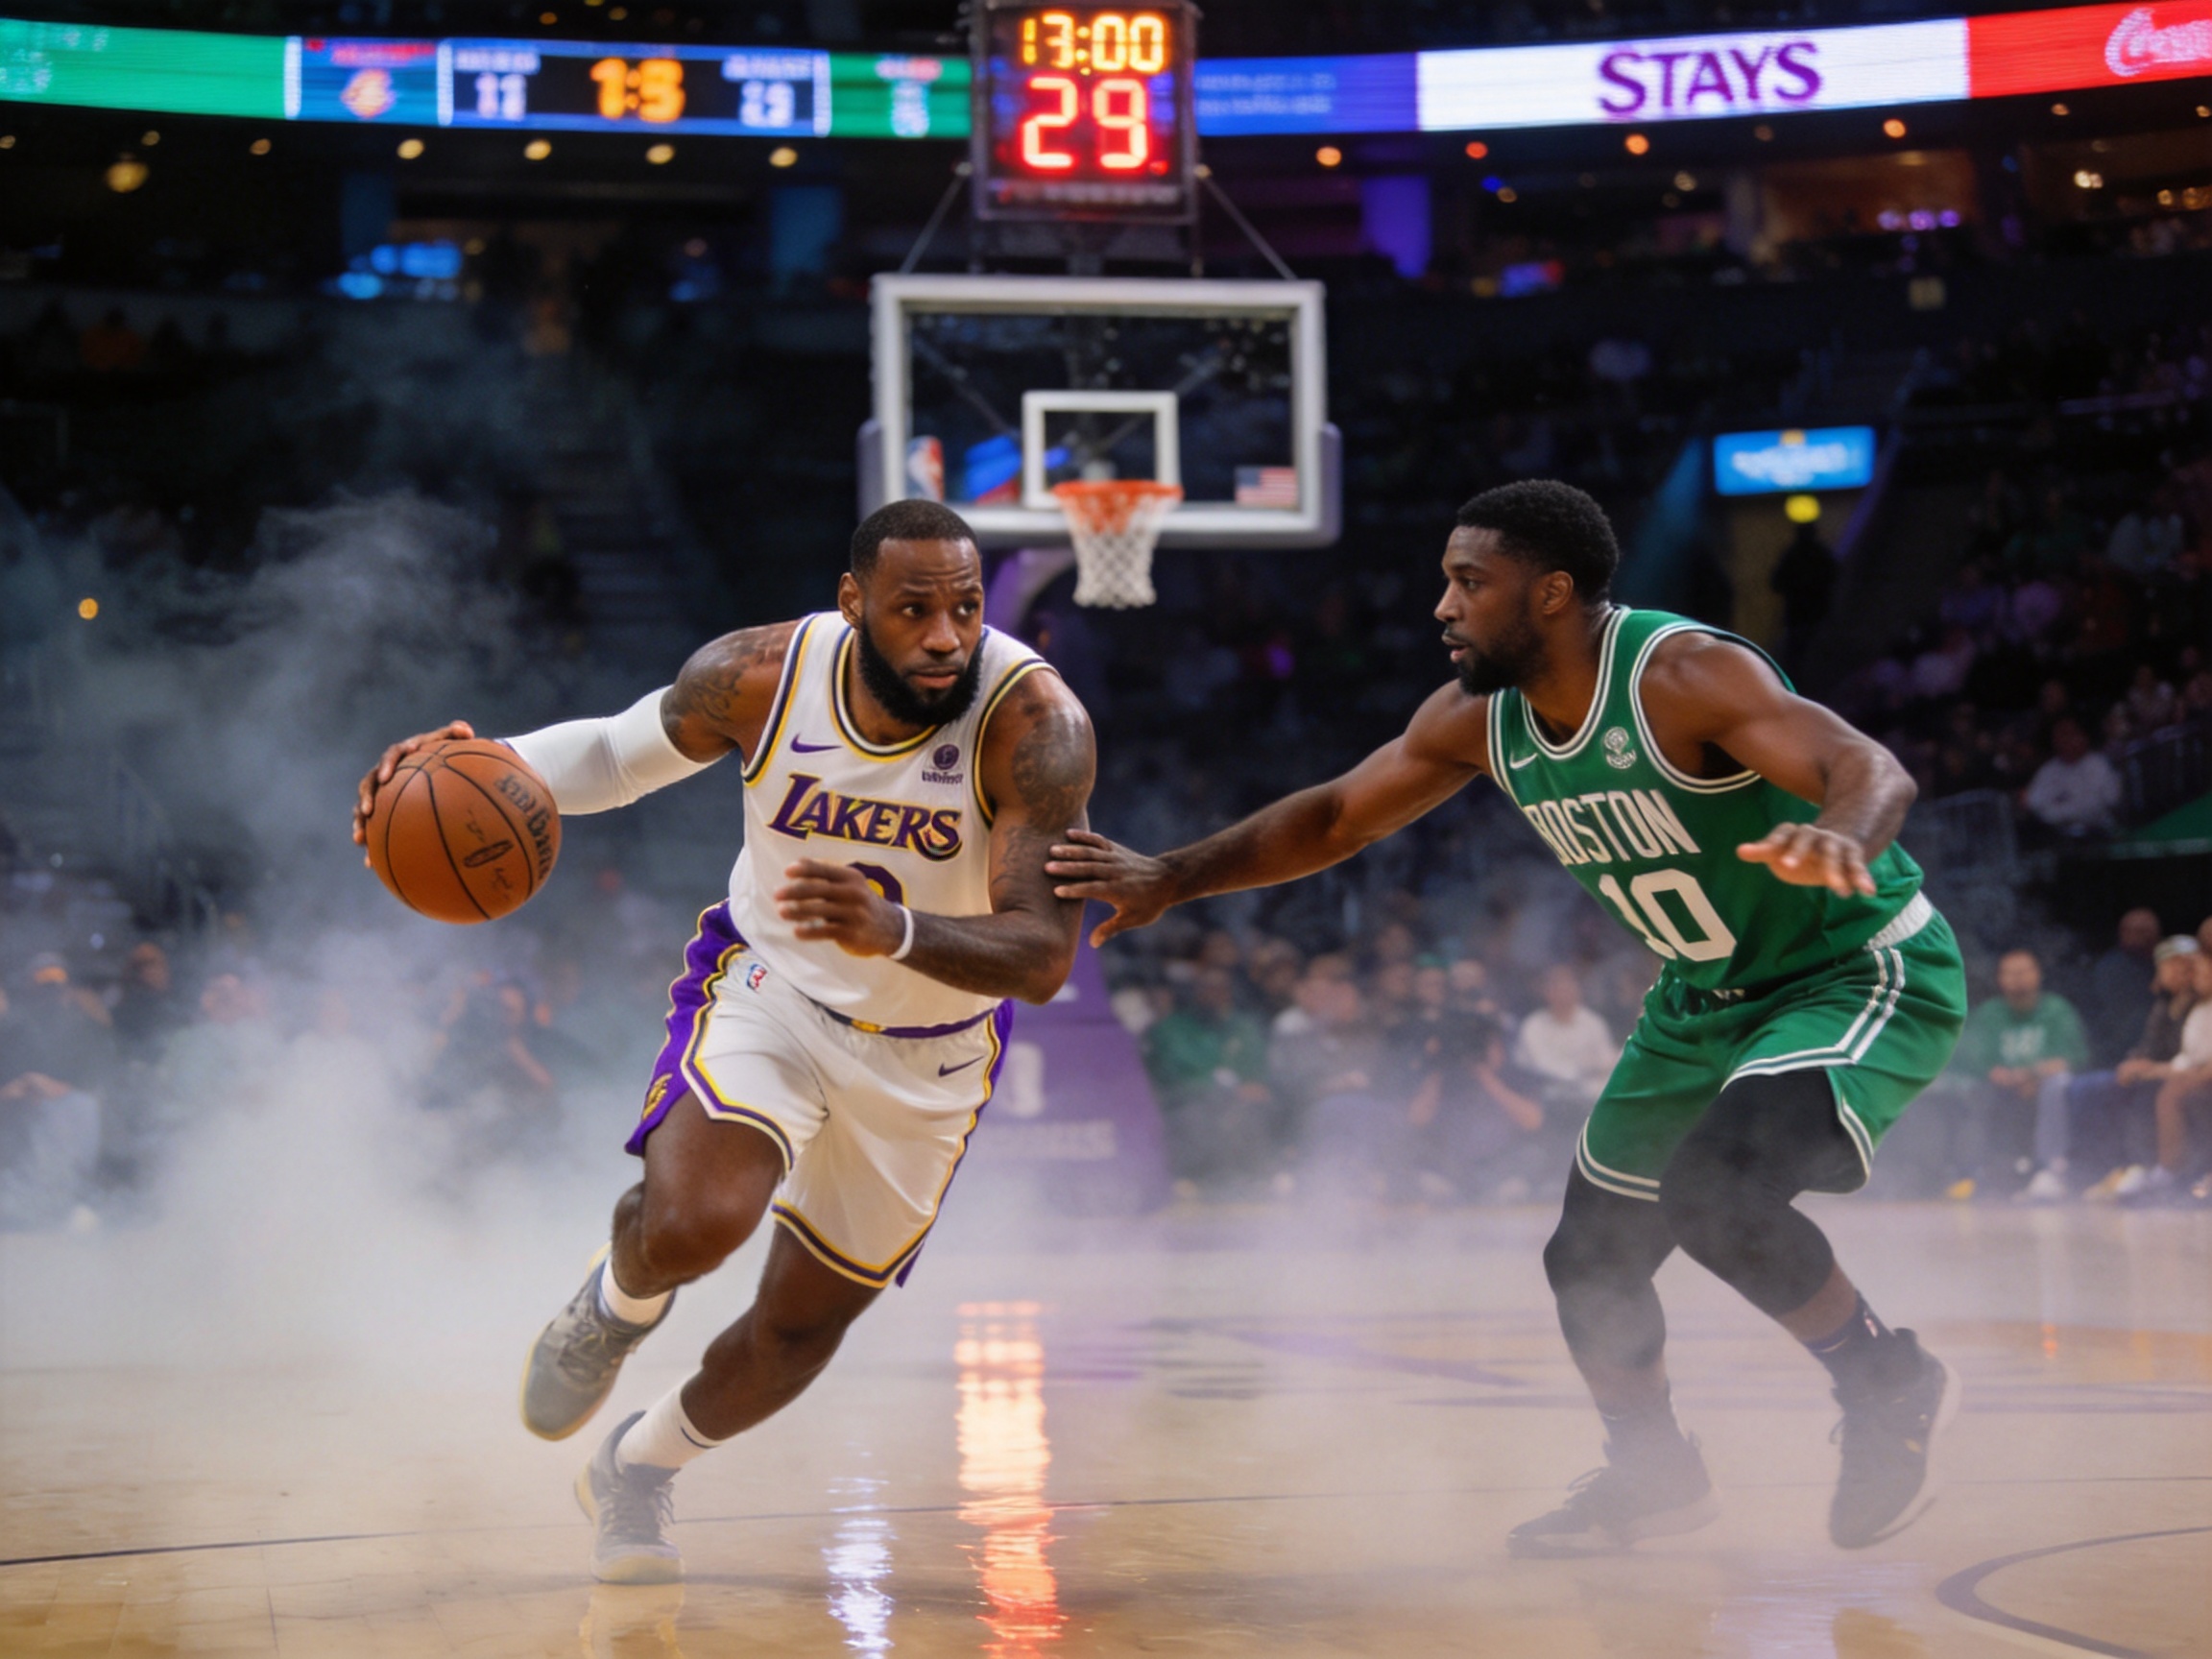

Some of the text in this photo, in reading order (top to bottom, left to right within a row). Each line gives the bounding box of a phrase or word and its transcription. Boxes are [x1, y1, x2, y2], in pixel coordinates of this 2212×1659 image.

[1022, 13, 1166, 74] 13:00
[1599, 42, 1821, 115] STAYS
[1022, 77, 1147, 169] 29
[768, 774, 963, 861] LAKERS
[1522, 789, 1701, 865] BOSTON
[1599, 869, 1737, 961] 10
